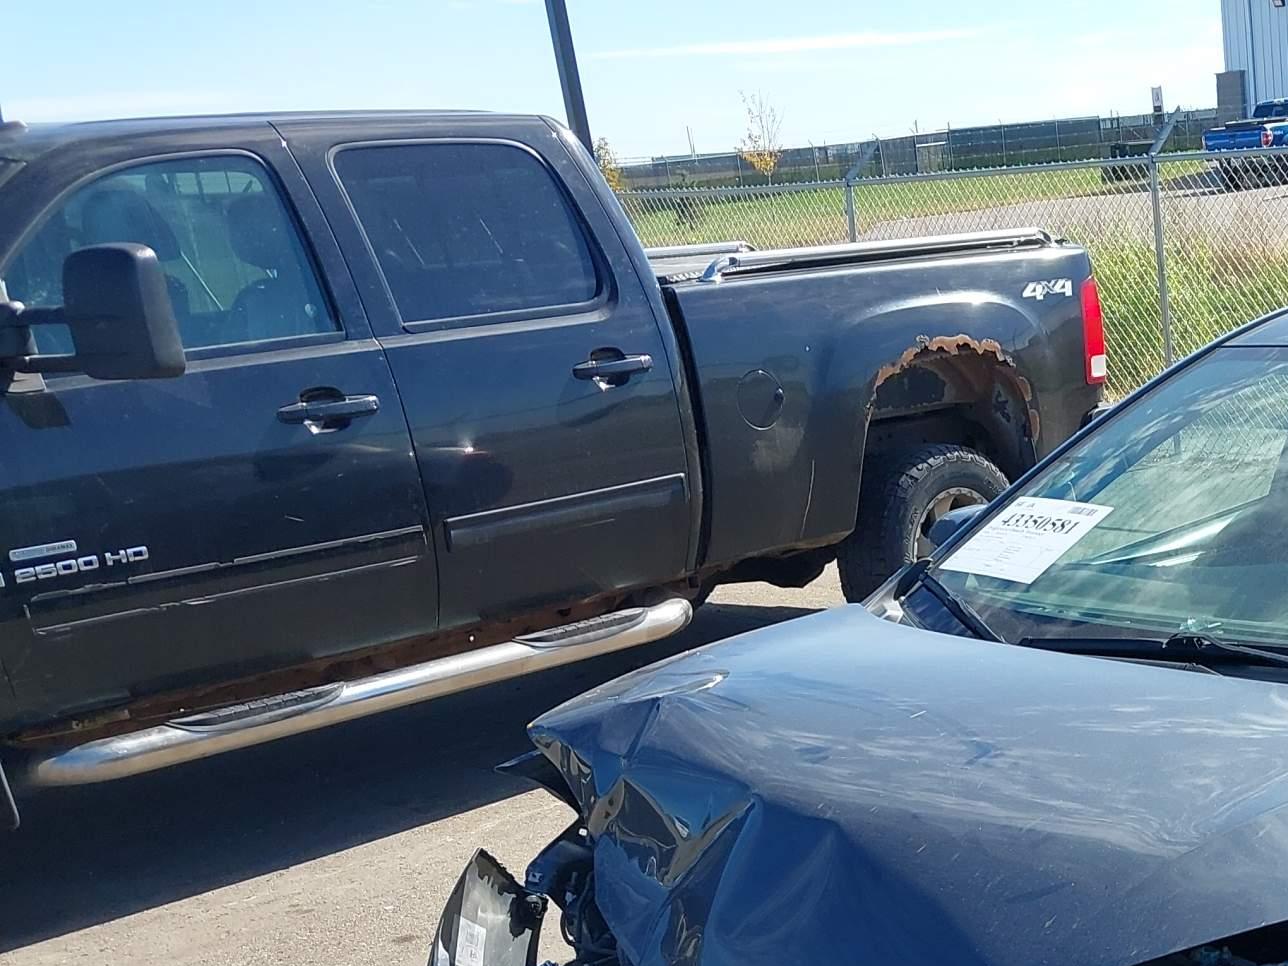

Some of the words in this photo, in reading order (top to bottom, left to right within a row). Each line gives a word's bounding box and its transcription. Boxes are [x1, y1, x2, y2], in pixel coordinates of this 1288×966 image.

[1002, 512, 1080, 535] 43350581
[14, 555, 99, 584] 2500
[104, 546, 149, 566] HD
